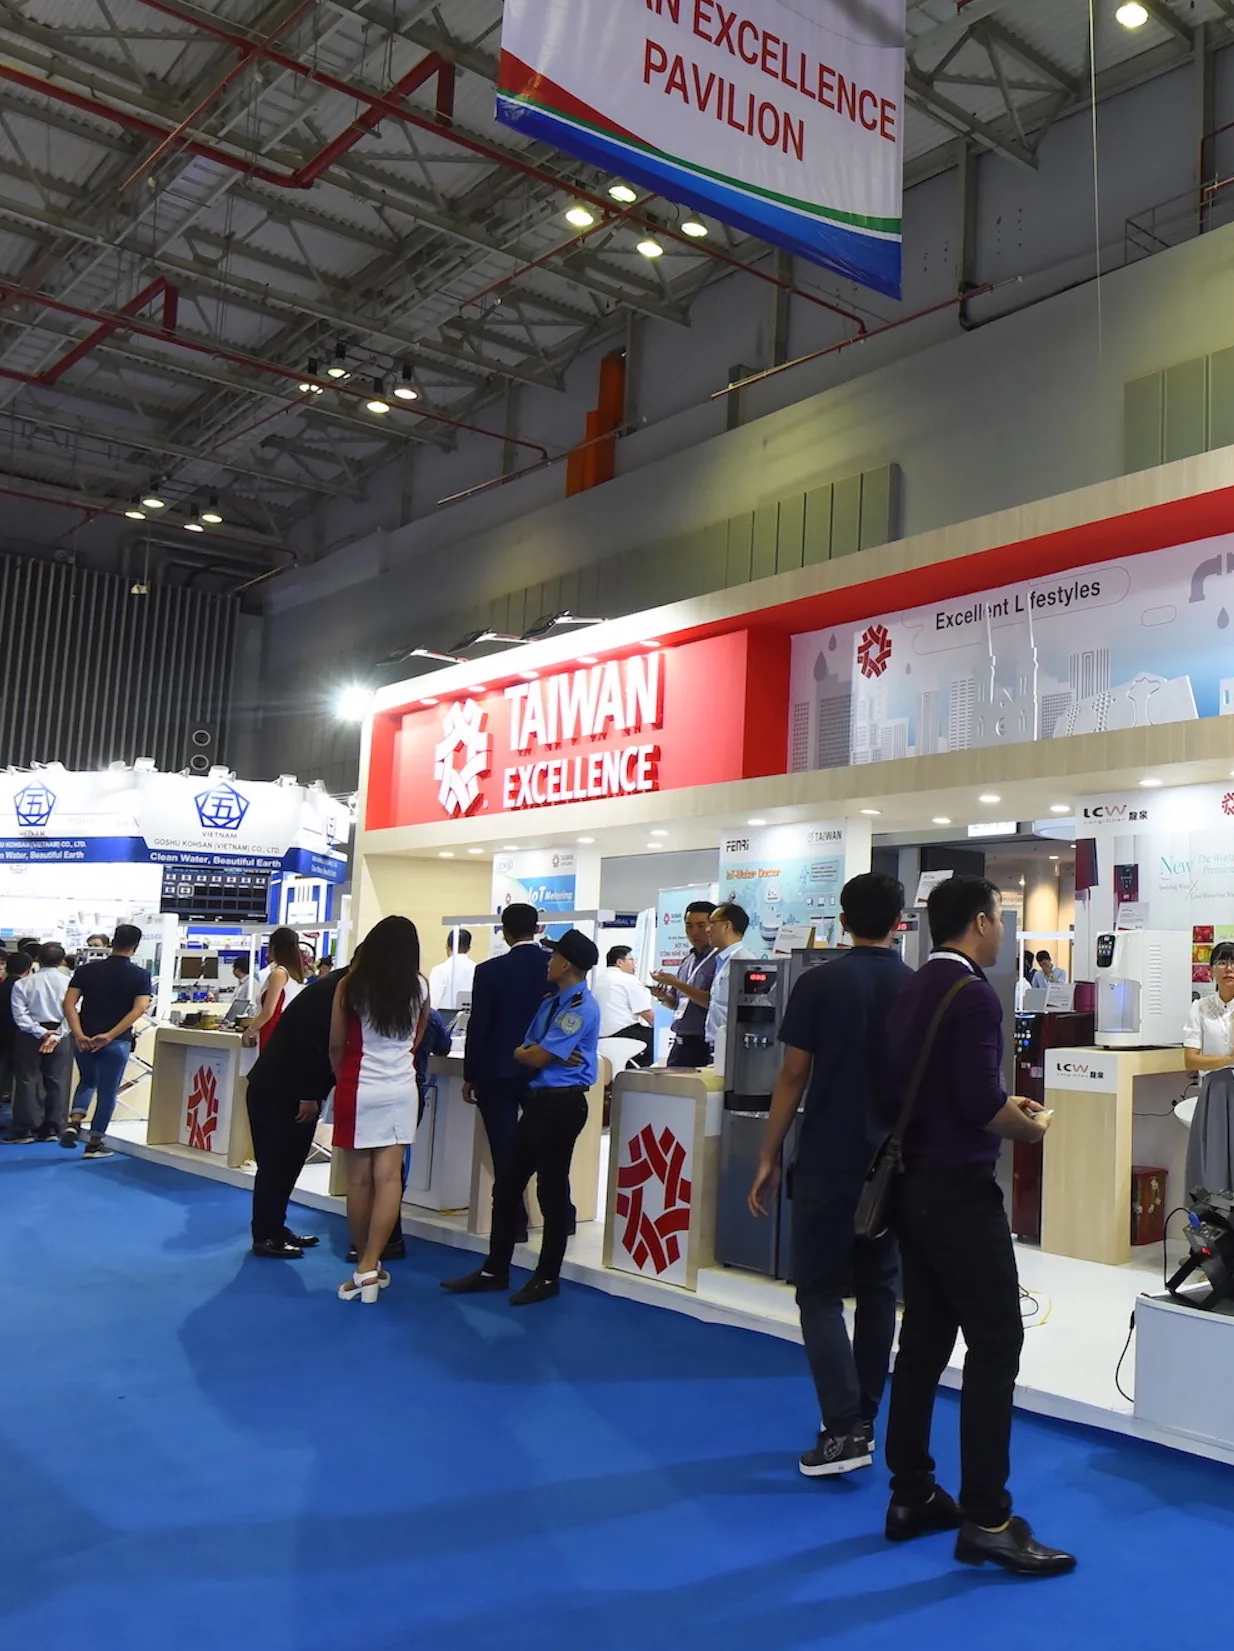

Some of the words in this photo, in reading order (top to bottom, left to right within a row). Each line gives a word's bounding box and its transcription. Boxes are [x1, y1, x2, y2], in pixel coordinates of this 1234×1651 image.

[692, 0, 896, 143] EXCELLENCE
[644, 38, 804, 161] PAVILION
[1015, 580, 1101, 613] Lfestyles
[503, 651, 664, 752] TAIWAN
[503, 744, 658, 810] EXCELLENCE
[153, 838, 181, 847] GOSHU
[182, 840, 213, 849] KOHSAN
[214, 842, 250, 852] (VIETNAM)
[202, 831, 238, 839] VIETNAM
[815, 830, 843, 841] TAIWAN
[5, 852, 28, 860] Water,
[30, 851, 62, 859] Beautiful
[64, 851, 84, 859] Earth
[150, 852, 178, 862] Clean
[180, 854, 211, 865] Water,
[213, 856, 254, 866] Beautiful
[256, 859, 282, 869] Earth
[1159, 855, 1194, 878] New
